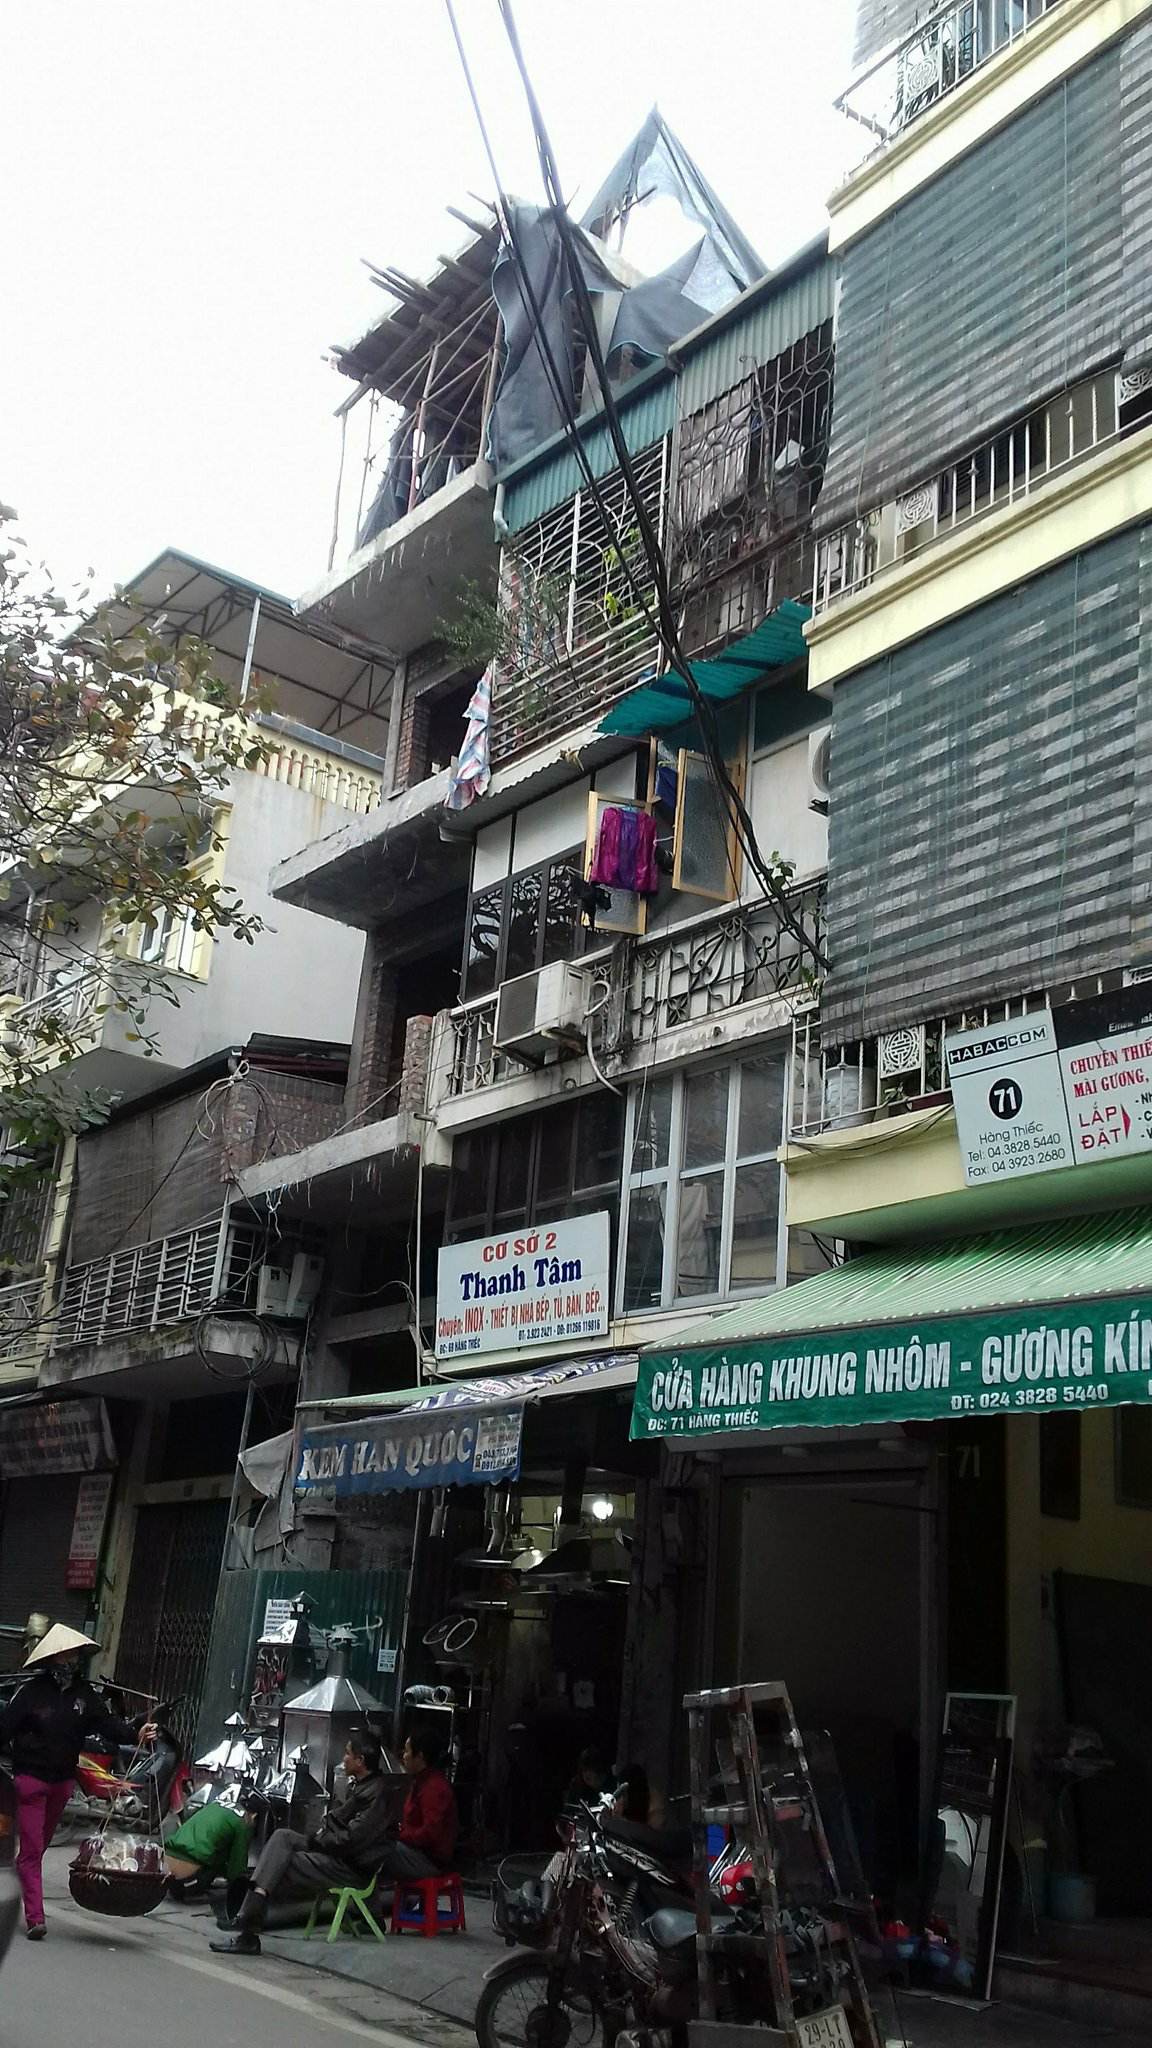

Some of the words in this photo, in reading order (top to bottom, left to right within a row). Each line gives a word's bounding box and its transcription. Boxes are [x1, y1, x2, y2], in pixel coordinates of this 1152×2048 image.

[950, 1028, 1046, 1063] HABACCOM
[1070, 1049, 1119, 1075] CHUYÊN
[994, 1087, 1017, 1113] 71
[1073, 1077, 1098, 1098] MÀI
[1078, 1101, 1117, 1128] LẮP
[979, 1130, 1011, 1145] Hàng
[1013, 1120, 1044, 1137] Thiếc
[1081, 1127, 1122, 1150] ĐẶT
[967, 1149, 986, 1162] Tel:
[968, 1165, 990, 1178] Fax:
[483, 1241, 508, 1262] CƠ
[513, 1229, 540, 1256] SỞ
[545, 1232, 557, 1251] 2
[460, 1264, 526, 1301] Thanh
[533, 1256, 582, 1288] Tâm
[464, 1305, 484, 1334] INOX
[490, 1300, 508, 1329] THIẾT
[519, 1297, 534, 1325] NHÀ
[651, 1357, 693, 1412] CỬA
[699, 1357, 764, 1408] HÀNG
[768, 1350, 858, 1402] KHUNG
[864, 1335, 951, 1394] NHÔM
[981, 1325, 1093, 1385] GƯƠNG
[950, 1394, 975, 1411] ĐT:
[979, 1392, 1010, 1409] 024
[1015, 1387, 1057, 1406] 3828
[1063, 1383, 1108, 1401] 5440
[647, 1418, 667, 1431] ĐC:
[670, 1417, 684, 1430] 71
[688, 1412, 721, 1428] HÀNG
[724, 1407, 759, 1426] THIẾC
[297, 1444, 348, 1480] KEM
